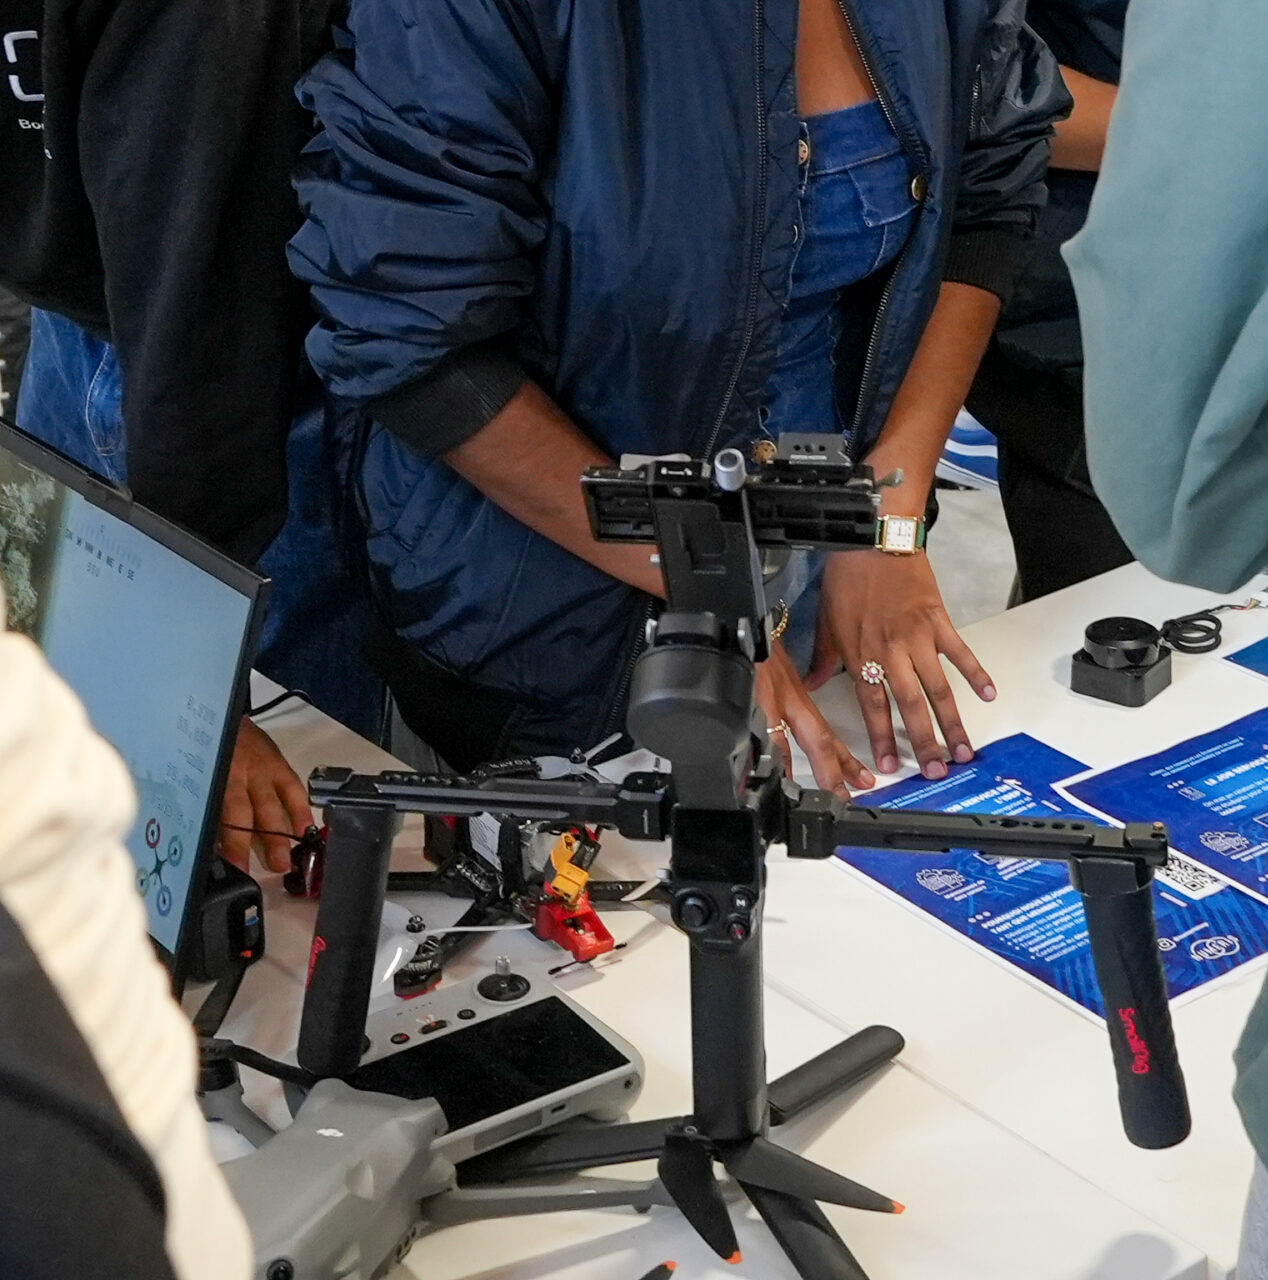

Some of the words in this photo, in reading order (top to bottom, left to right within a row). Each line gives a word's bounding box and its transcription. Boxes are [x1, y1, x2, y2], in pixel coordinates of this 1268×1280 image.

[1216, 770, 1236, 782] JOB
[959, 788, 1005, 808] SERVICE
[981, 908, 1023, 929] POURQUOI
[1019, 899, 1044, 911] NOUS
[990, 922, 1013, 934] TANT
[1011, 914, 1029, 925] QUE
[1026, 901, 1059, 918] MEMBRE
